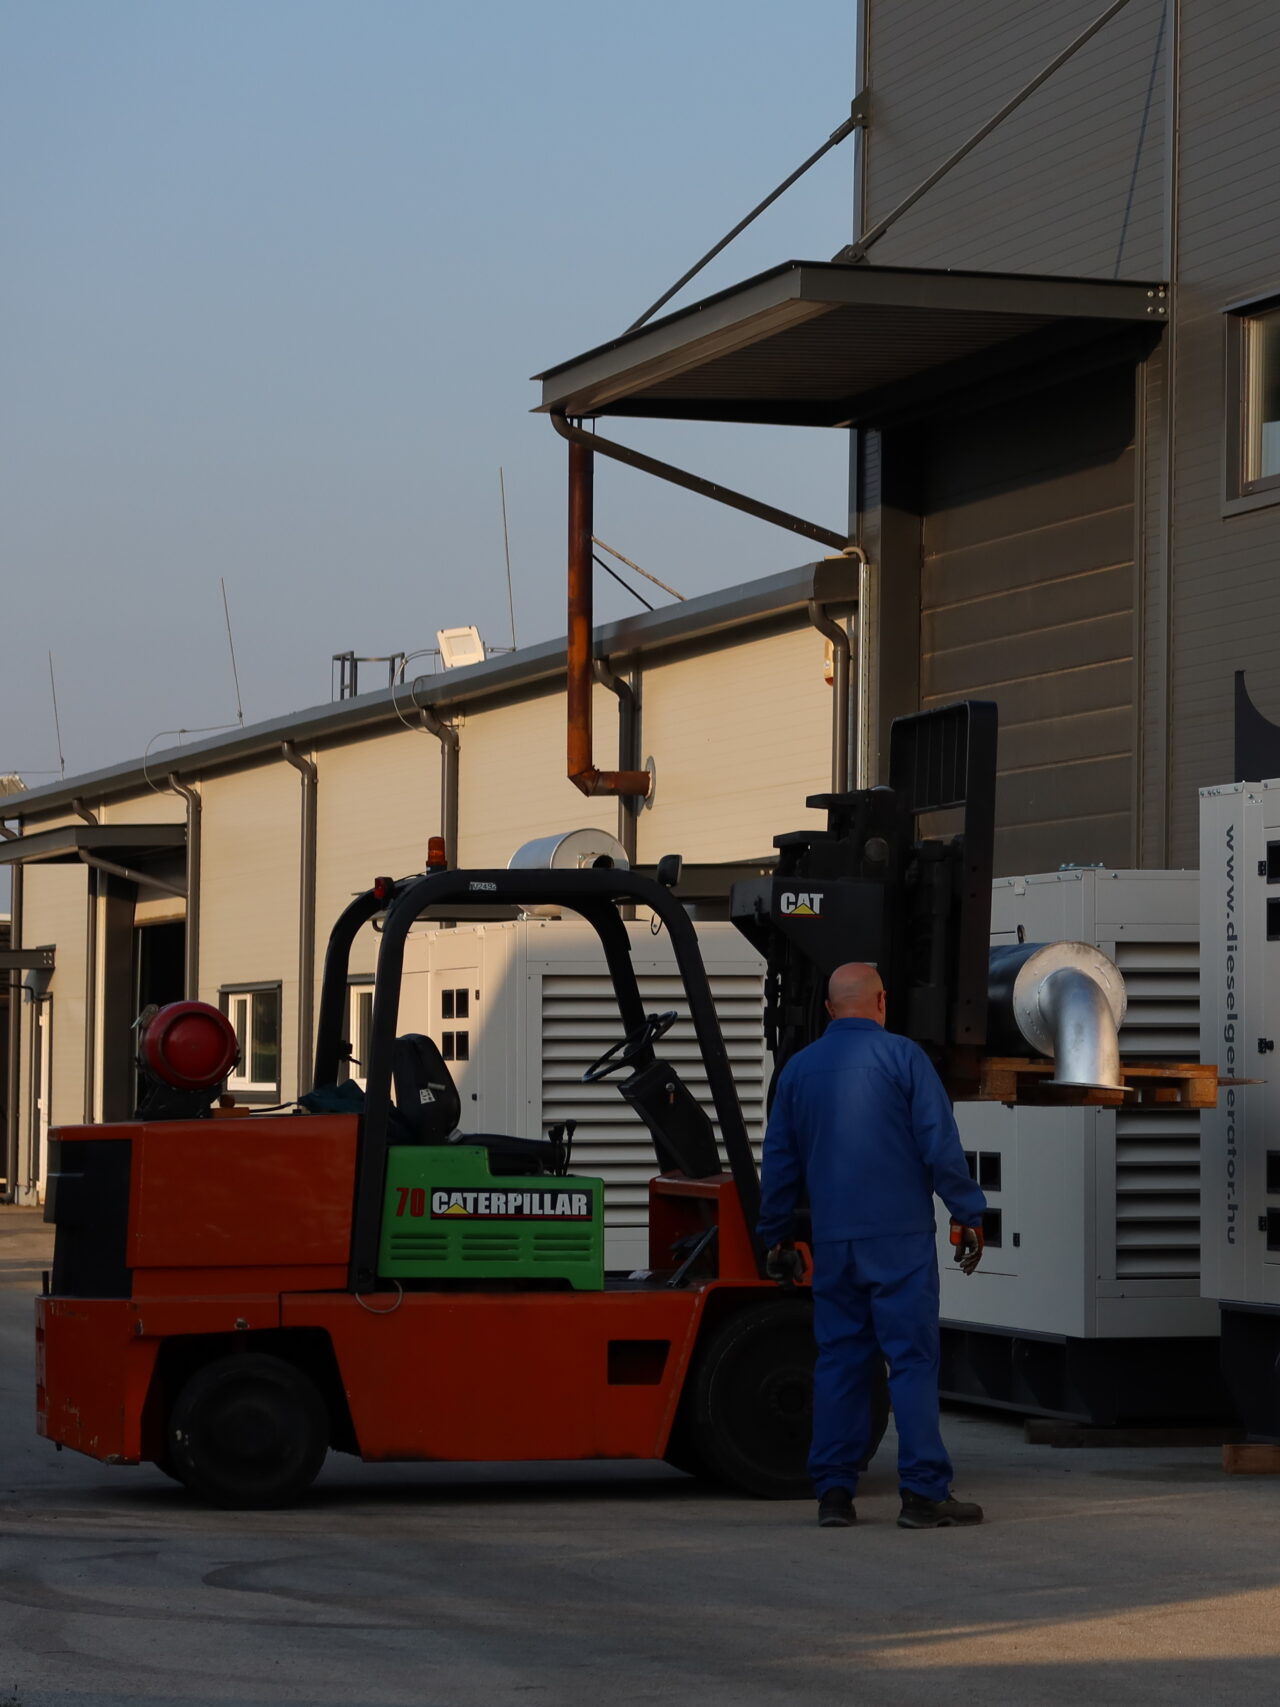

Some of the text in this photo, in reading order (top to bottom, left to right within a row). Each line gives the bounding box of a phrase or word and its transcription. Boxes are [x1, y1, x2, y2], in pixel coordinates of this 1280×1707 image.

[780, 892, 824, 914] CAT
[396, 1187, 588, 1217] 70 CATERPILLAR
